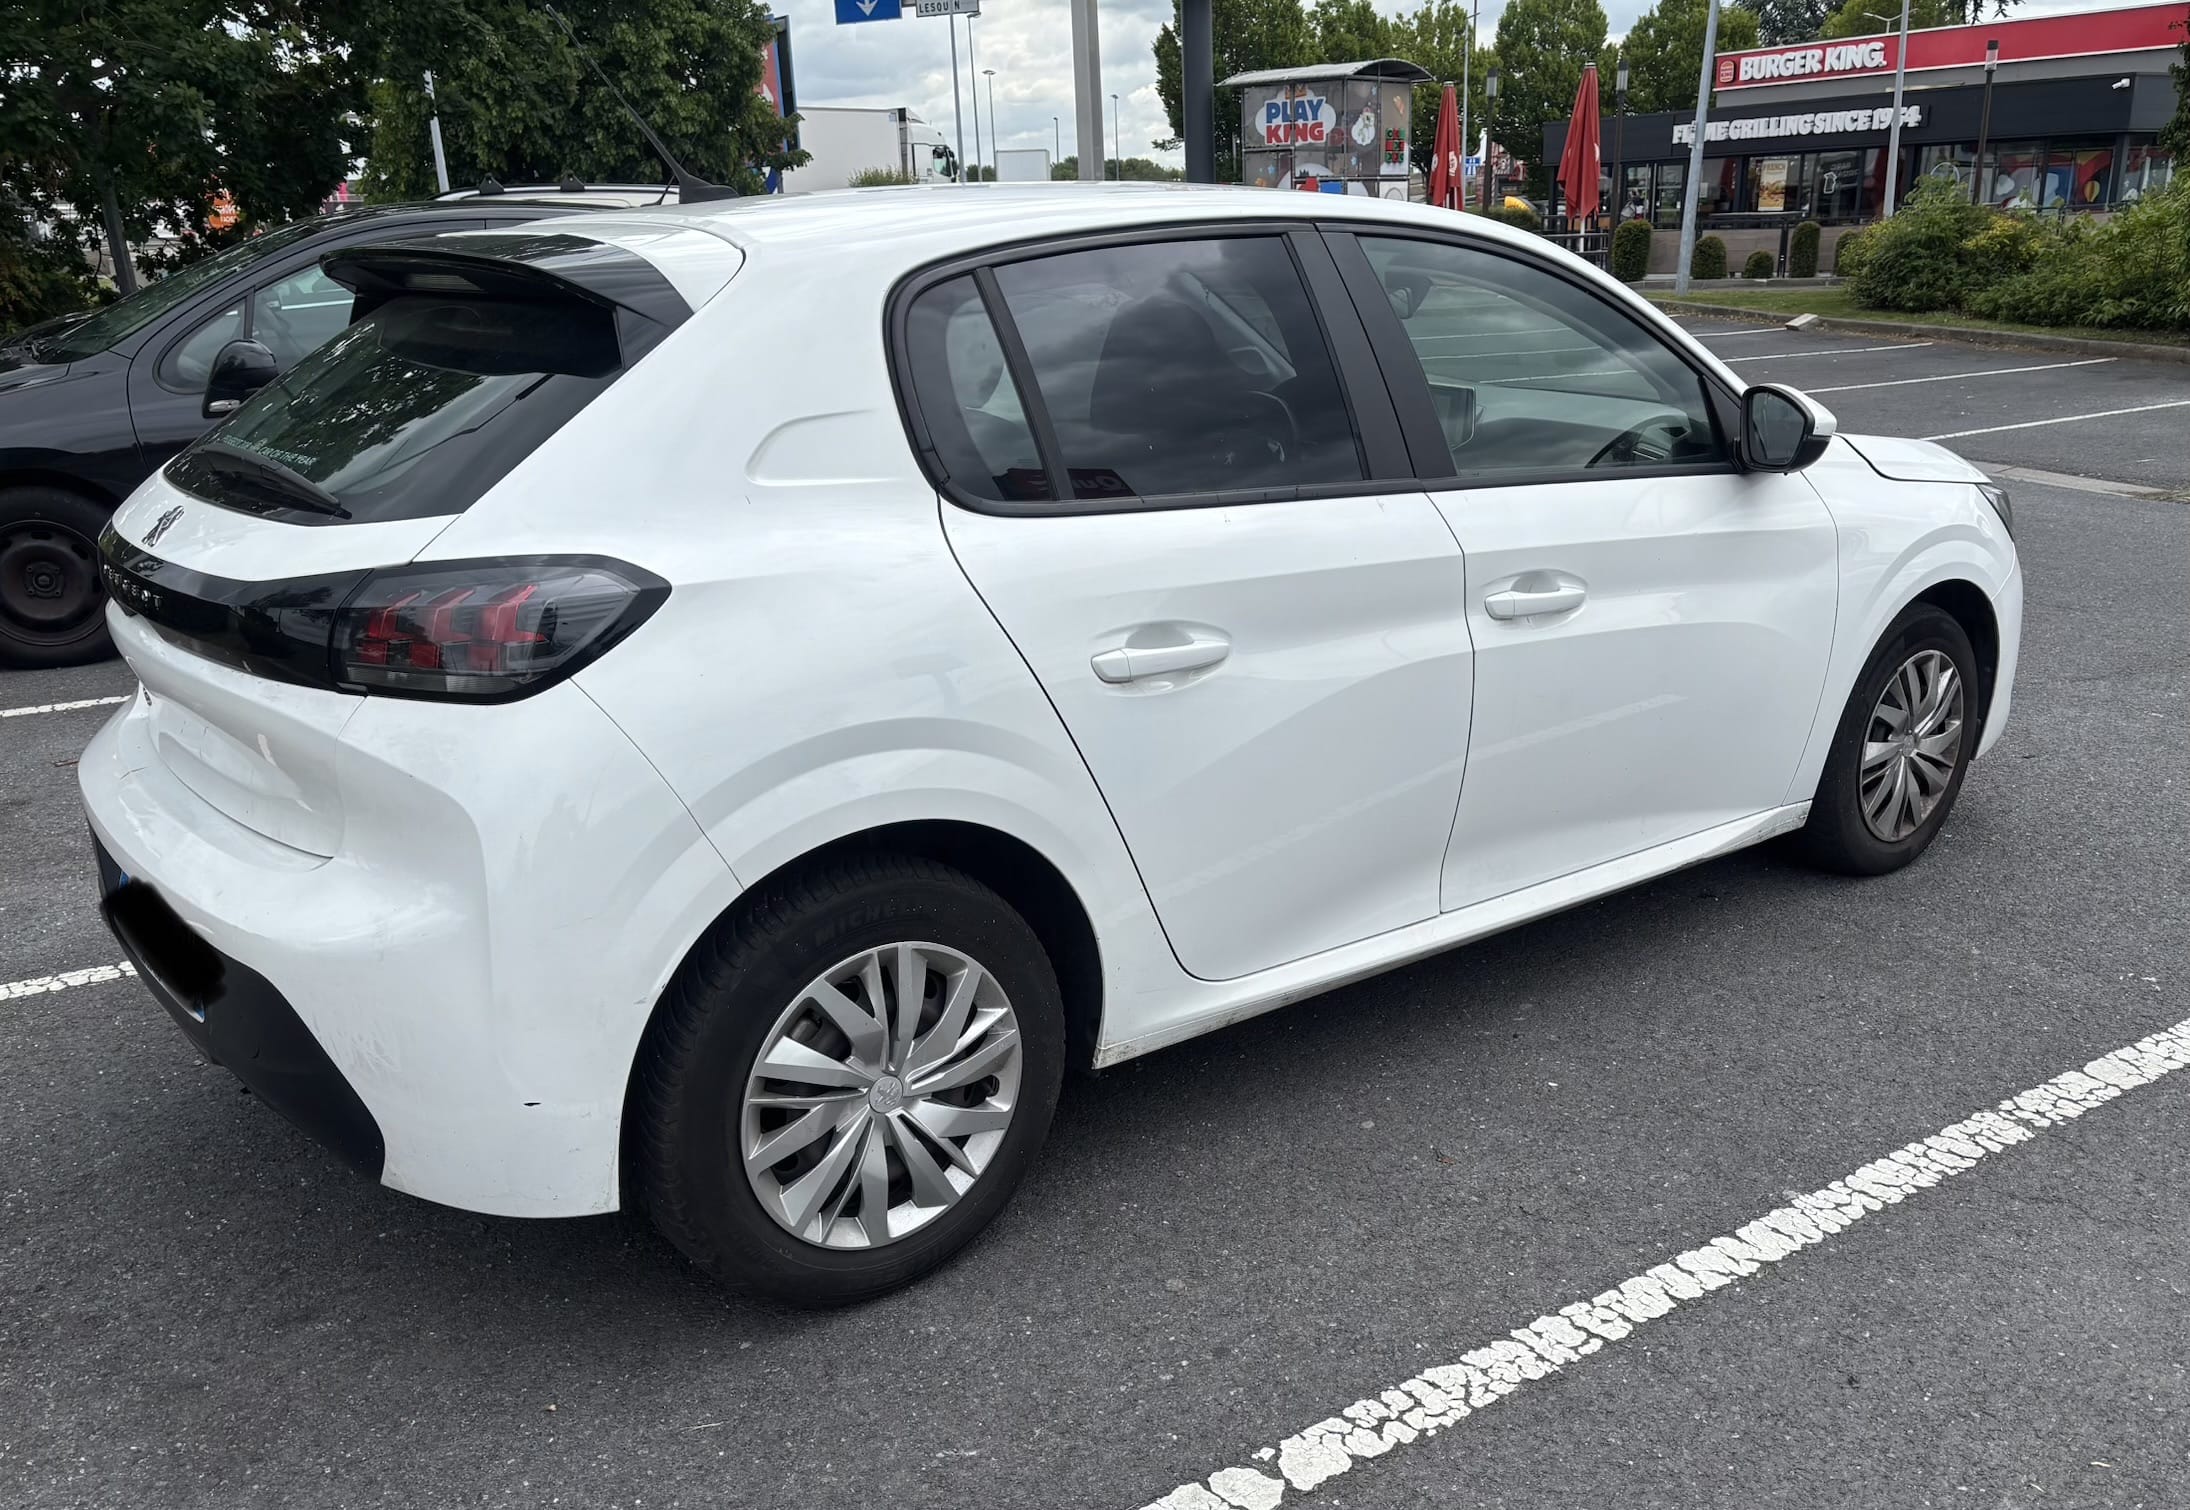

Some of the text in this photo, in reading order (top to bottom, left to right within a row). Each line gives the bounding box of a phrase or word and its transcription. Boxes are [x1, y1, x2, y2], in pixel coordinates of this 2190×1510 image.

[919, 0, 960, 13] LESQUN
[1738, 41, 1886, 82] BURGER KING
[1266, 99, 1325, 124] PLAY
[1266, 122, 1324, 144] KING
[1672, 121, 1730, 144] FLME
[1729, 113, 1815, 140] GRILLING
[1813, 110, 1872, 135] SINCE
